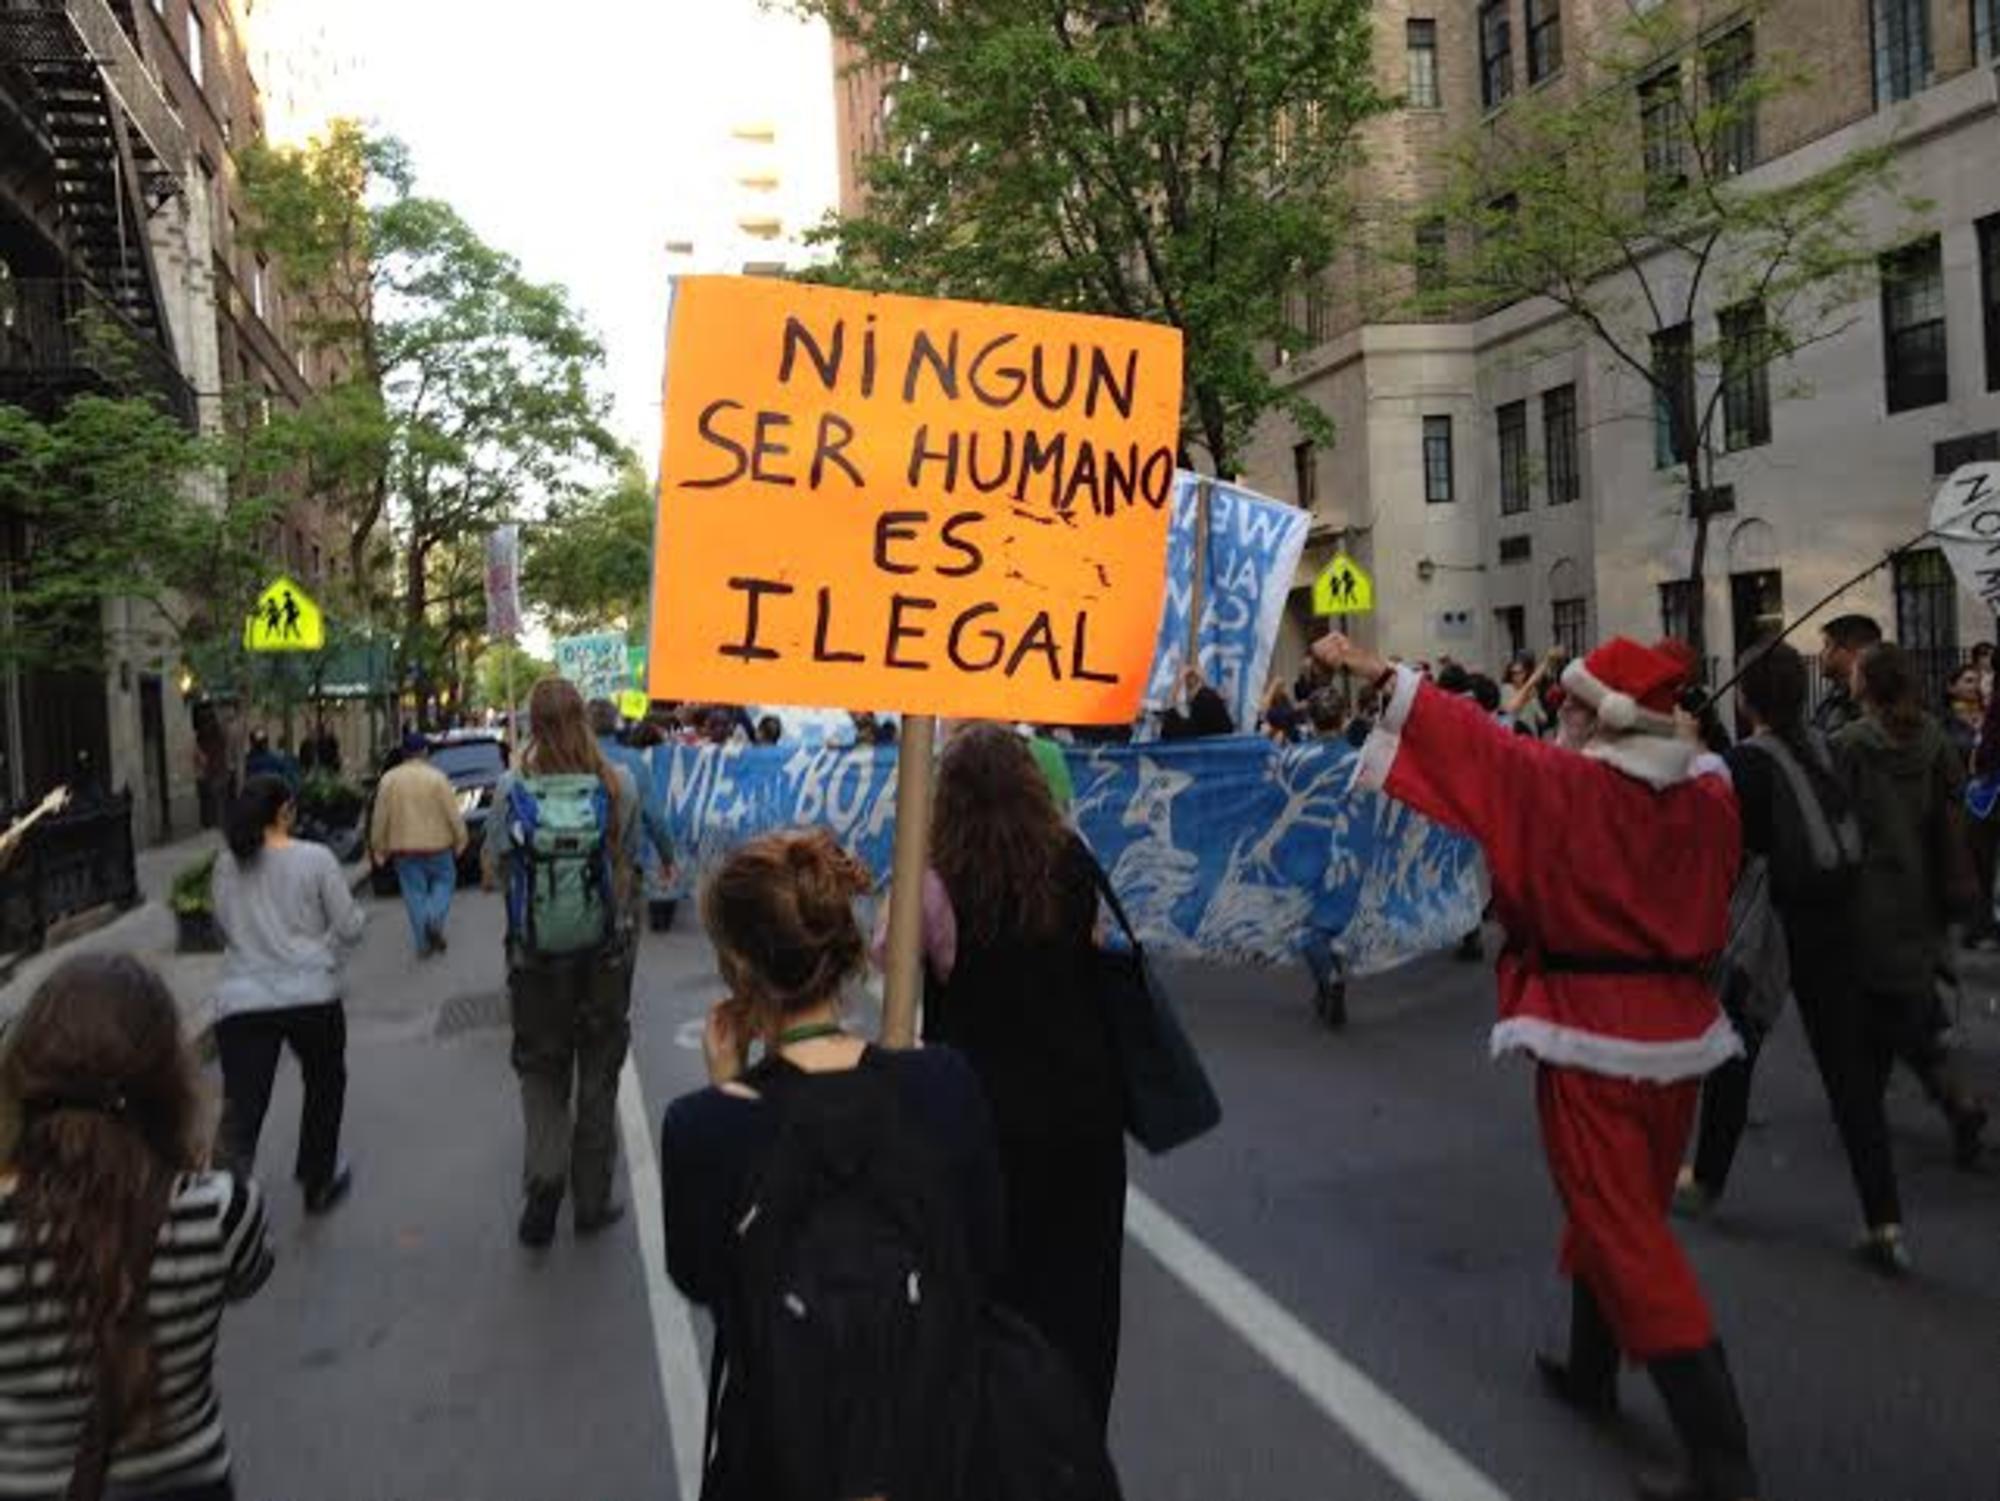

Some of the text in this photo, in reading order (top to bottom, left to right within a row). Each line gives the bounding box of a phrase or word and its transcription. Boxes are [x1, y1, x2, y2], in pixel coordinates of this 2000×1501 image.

[679, 399, 1173, 516] SER HUMANO
[873, 511, 986, 577] ES
[718, 577, 1120, 684] ILEGAL
